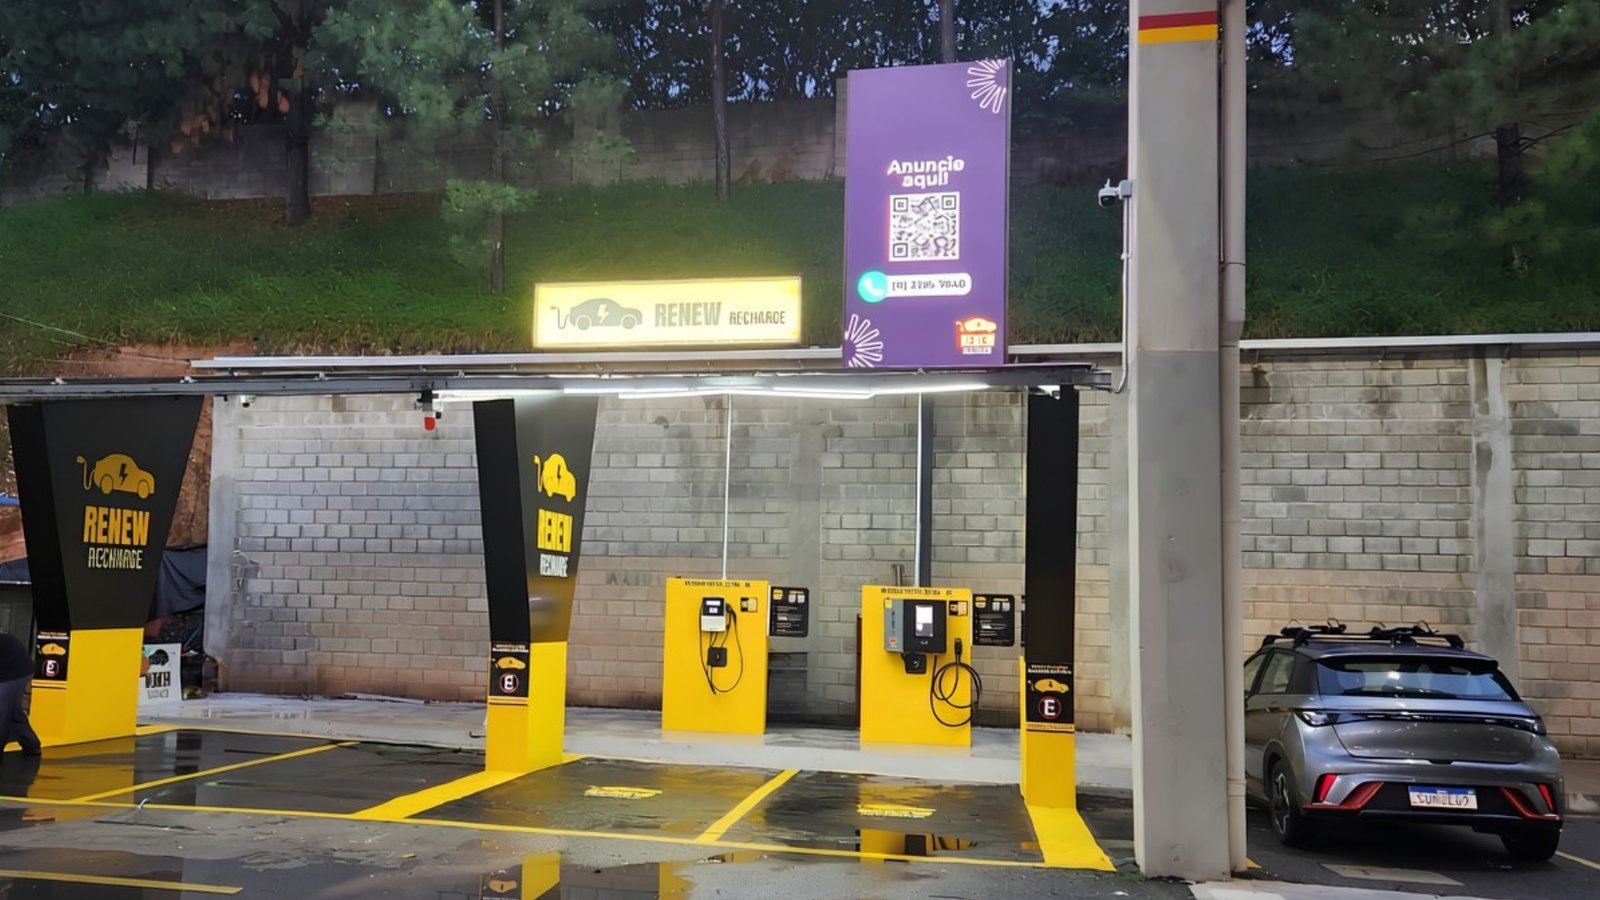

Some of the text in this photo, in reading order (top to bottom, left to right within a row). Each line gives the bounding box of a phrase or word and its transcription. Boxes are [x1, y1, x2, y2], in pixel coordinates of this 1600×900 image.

[655, 302, 786, 327] RENEW RECHARGE
[83, 505, 151, 546] RENEW
[1043, 699, 1056, 716] E
